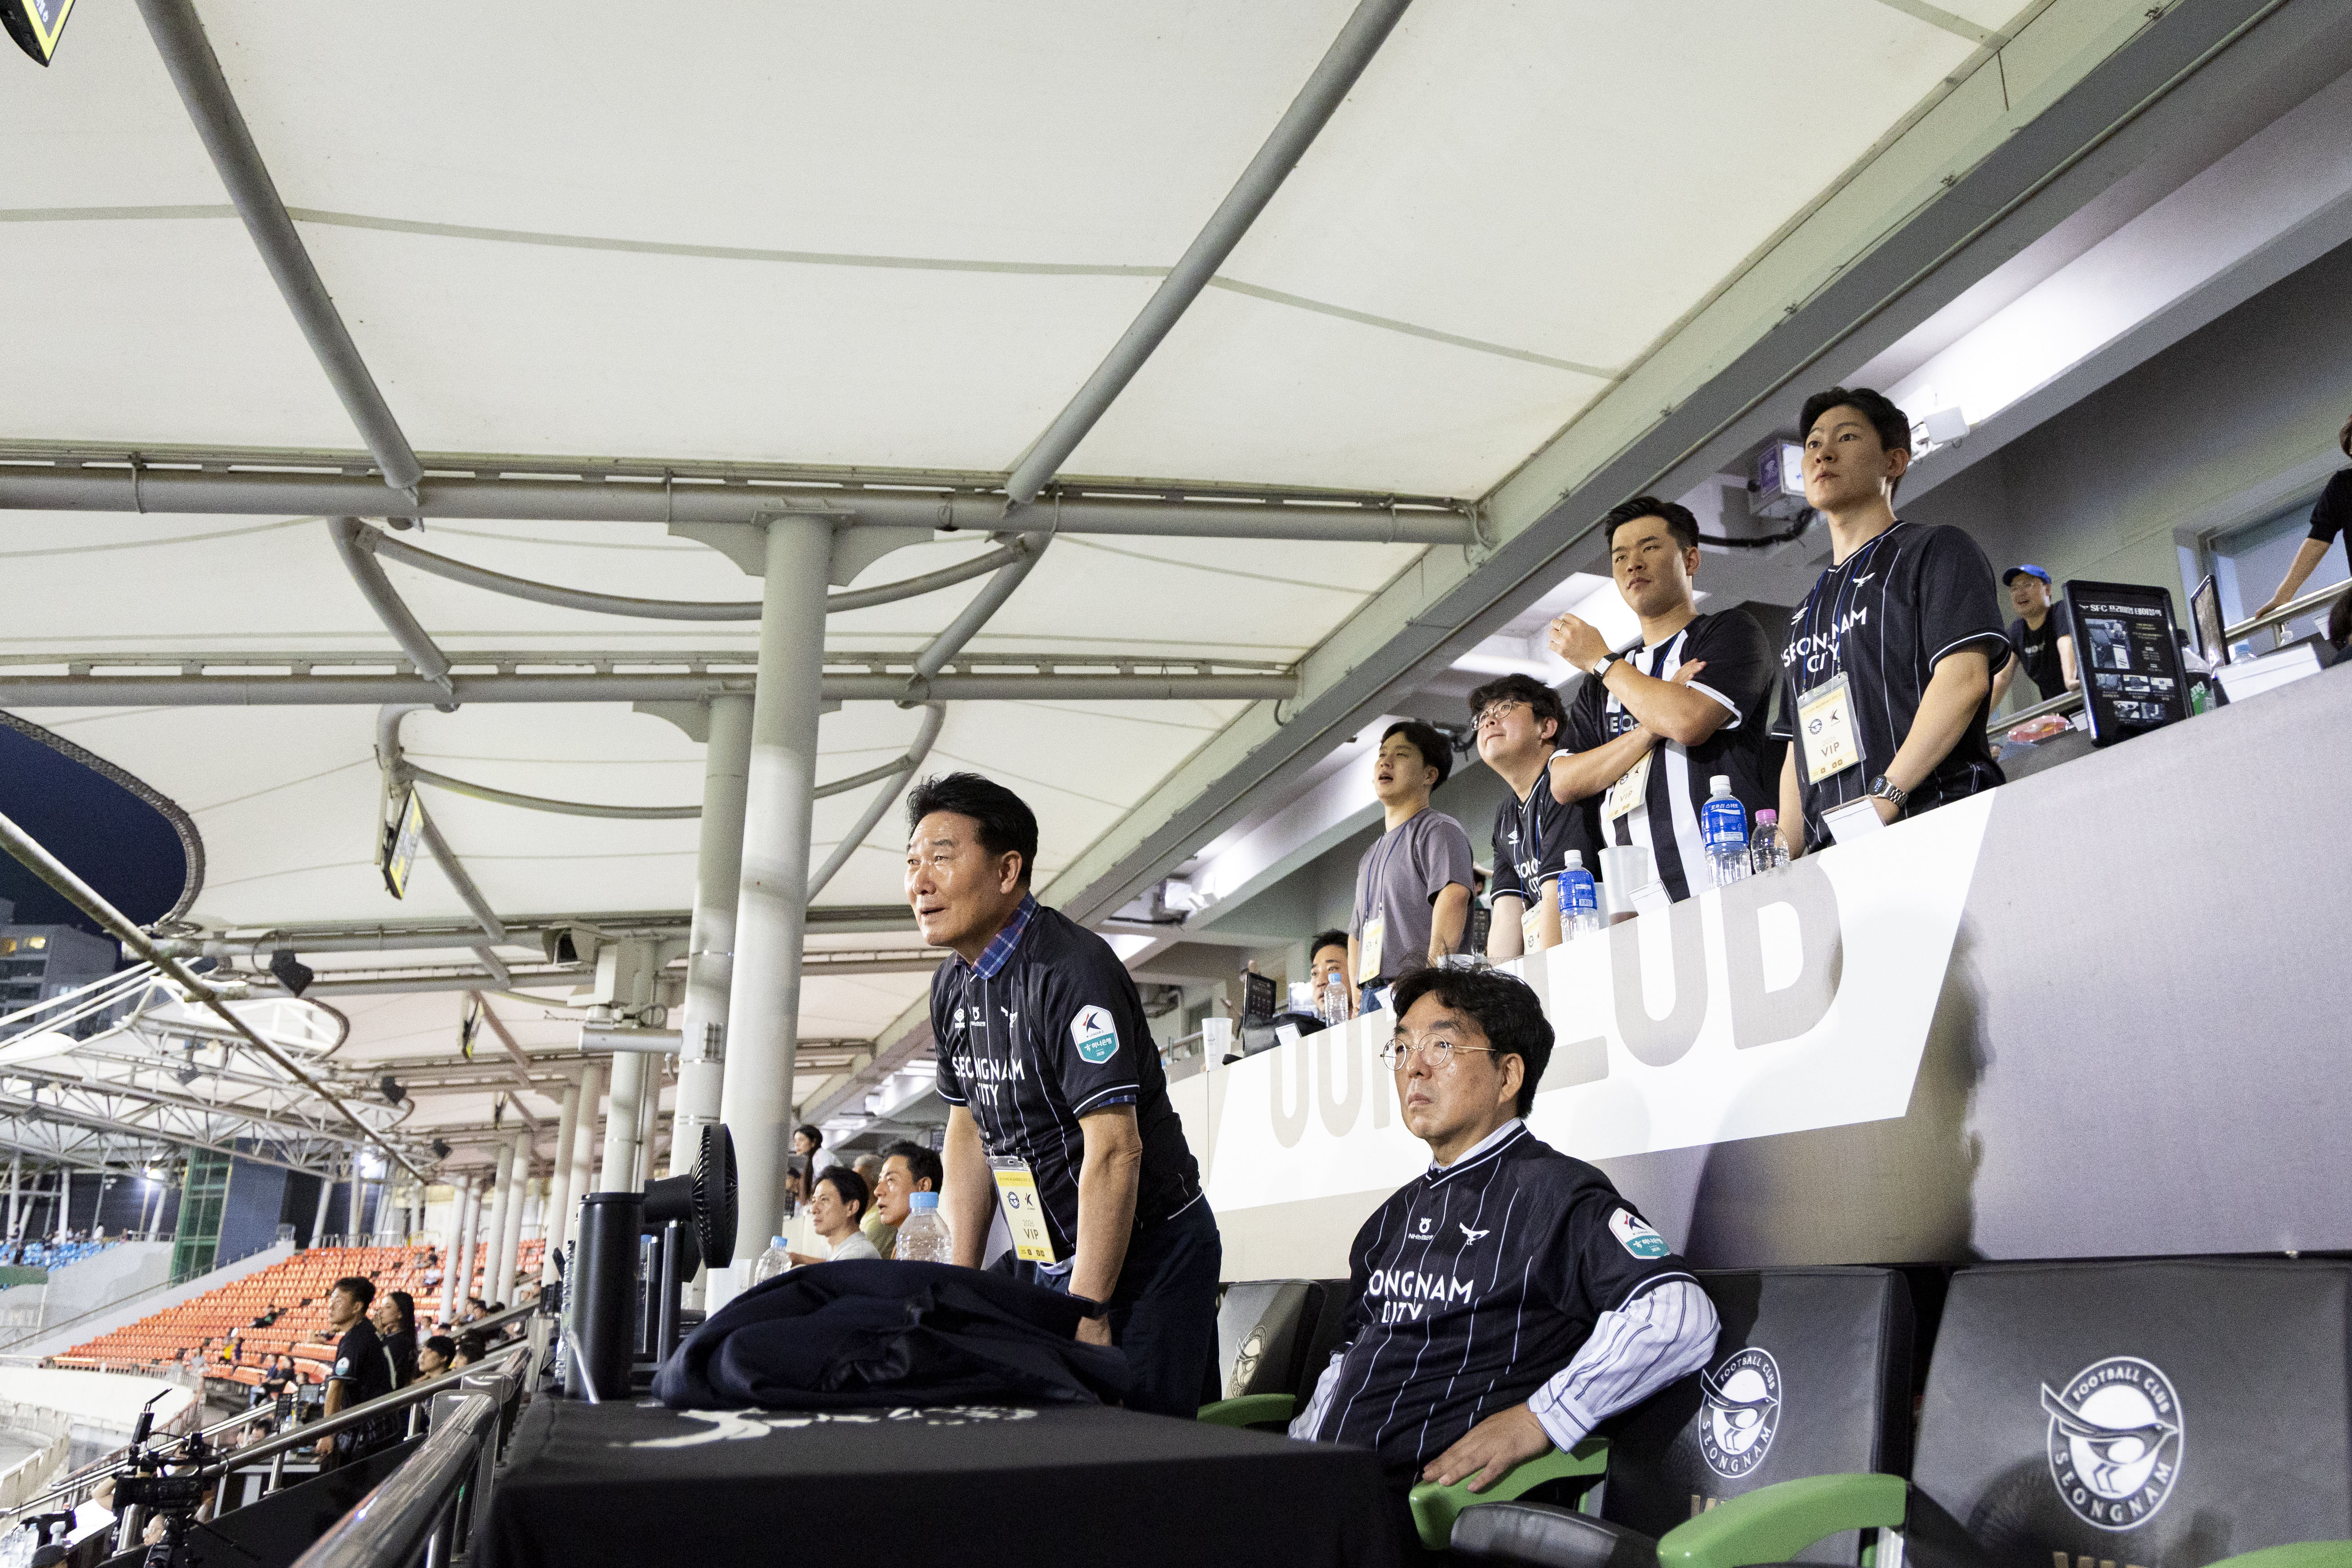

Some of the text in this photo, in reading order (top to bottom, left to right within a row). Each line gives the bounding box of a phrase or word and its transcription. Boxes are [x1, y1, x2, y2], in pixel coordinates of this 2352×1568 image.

[1782, 607, 1867, 667] SEONNAM
[1807, 642, 1839, 672] CIY
[1821, 742, 1840, 757] VIP
[1620, 791, 1633, 802] VIP
[1529, 876, 1541, 893] CIT
[1024, 1228, 1038, 1240] VIP
[1364, 1269, 1473, 1304] ONGNAM
[1720, 1356, 1775, 1389] FOOTBALL CLUB
[2072, 1367, 2170, 1413] FOOTBALL CLUB
[1703, 1420, 1772, 1472] SEONGNAM
[2055, 1452, 2172, 1522] SEONGNAM
